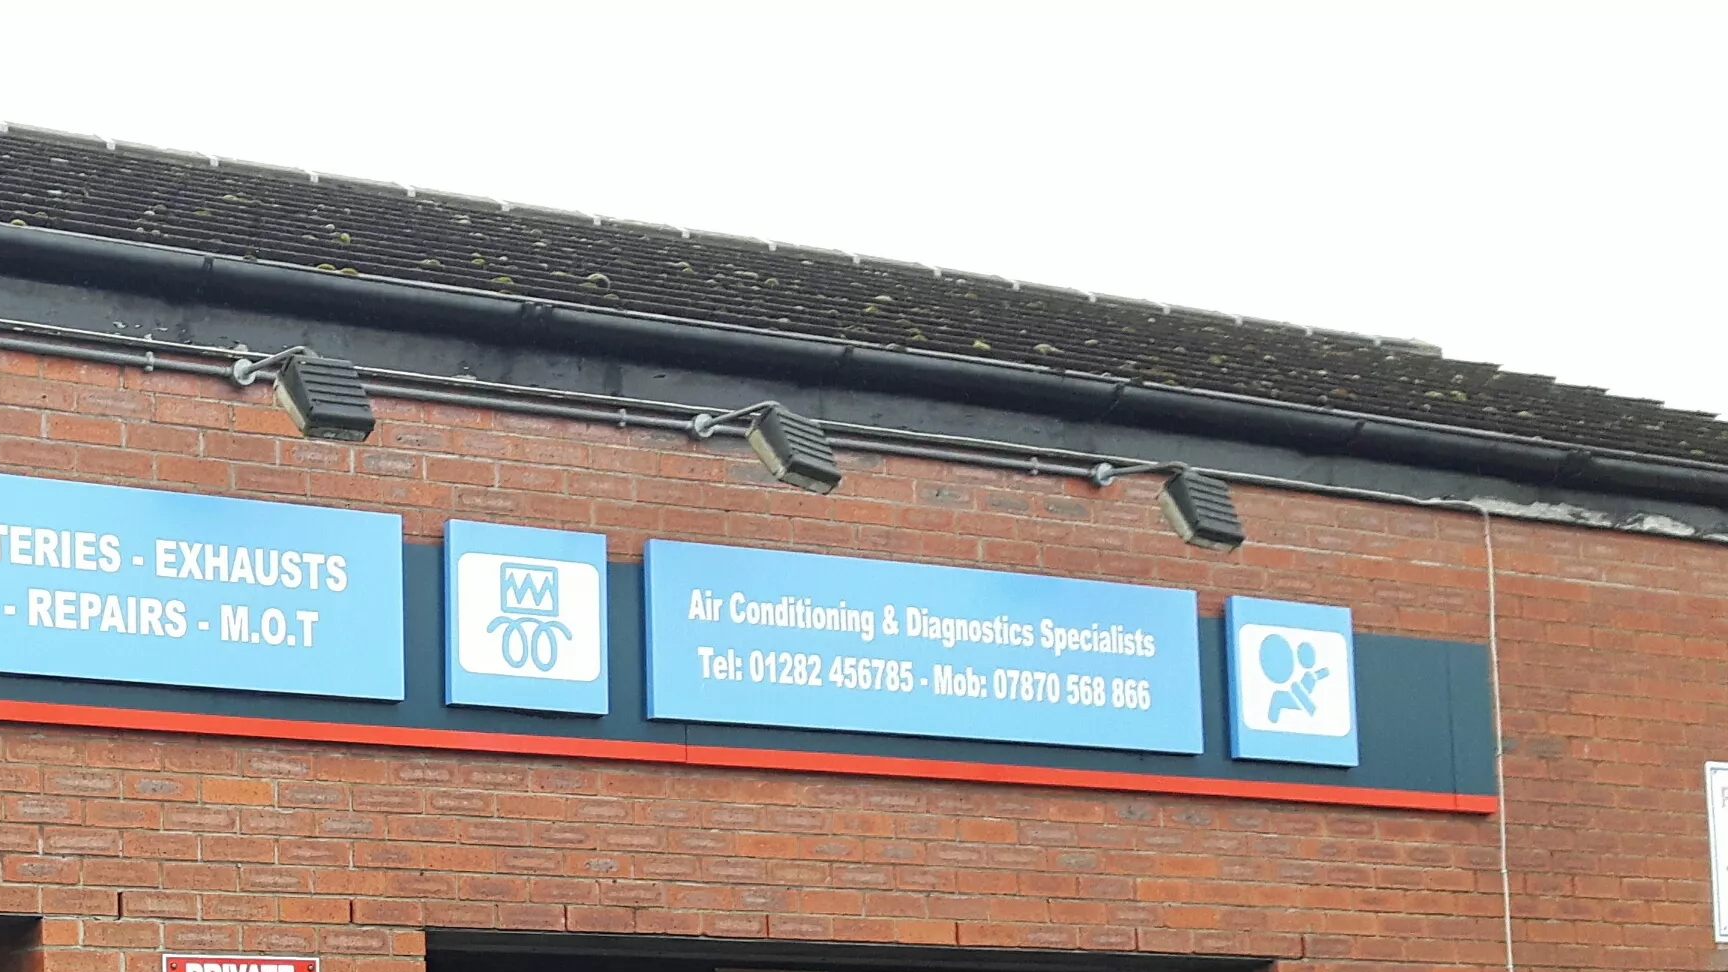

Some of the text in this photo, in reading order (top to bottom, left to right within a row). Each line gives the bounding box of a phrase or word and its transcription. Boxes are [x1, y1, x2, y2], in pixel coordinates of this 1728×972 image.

[132, 555, 144, 566] -
[155, 539, 348, 592] EXHAUSTS
[4, 605, 17, 615] -
[28, 588, 188, 638] REPAIRS
[197, 621, 210, 631] -
[220, 604, 319, 648] M.O.T
[688, 588, 1155, 658] Air Conditioning & Diagnostics Specialists
[698, 646, 743, 681] Tel:
[749, 650, 822, 687] 01282
[828, 657, 914, 692] 456785
[933, 664, 987, 698] Mob:
[993, 668, 1060, 703] 07870
[1066, 673, 1106, 707] 568
[1111, 678, 1151, 710] 866
